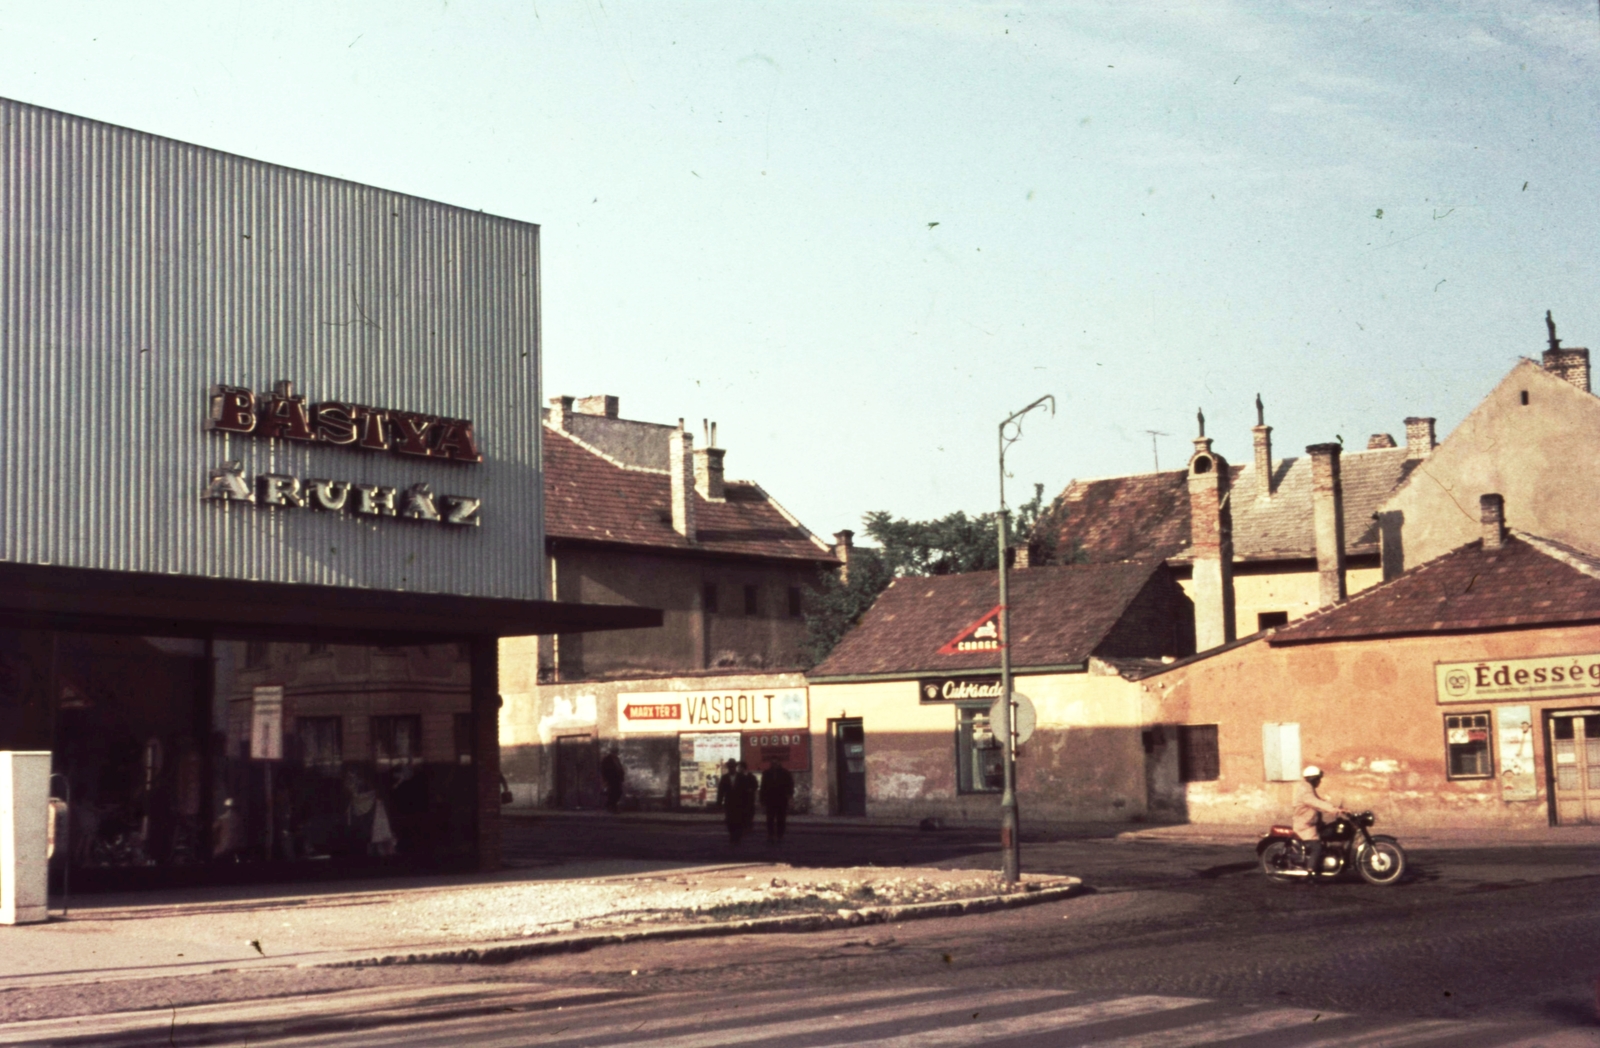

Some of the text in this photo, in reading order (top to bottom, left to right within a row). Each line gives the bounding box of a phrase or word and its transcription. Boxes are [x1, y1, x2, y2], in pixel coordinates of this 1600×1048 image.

[206, 380, 482, 462] BÁSTYA
[201, 460, 481, 525] ÁRUHÁZ
[630, 704, 678, 717] MARX TÉR 3
[687, 695, 775, 725] VASBOLT
